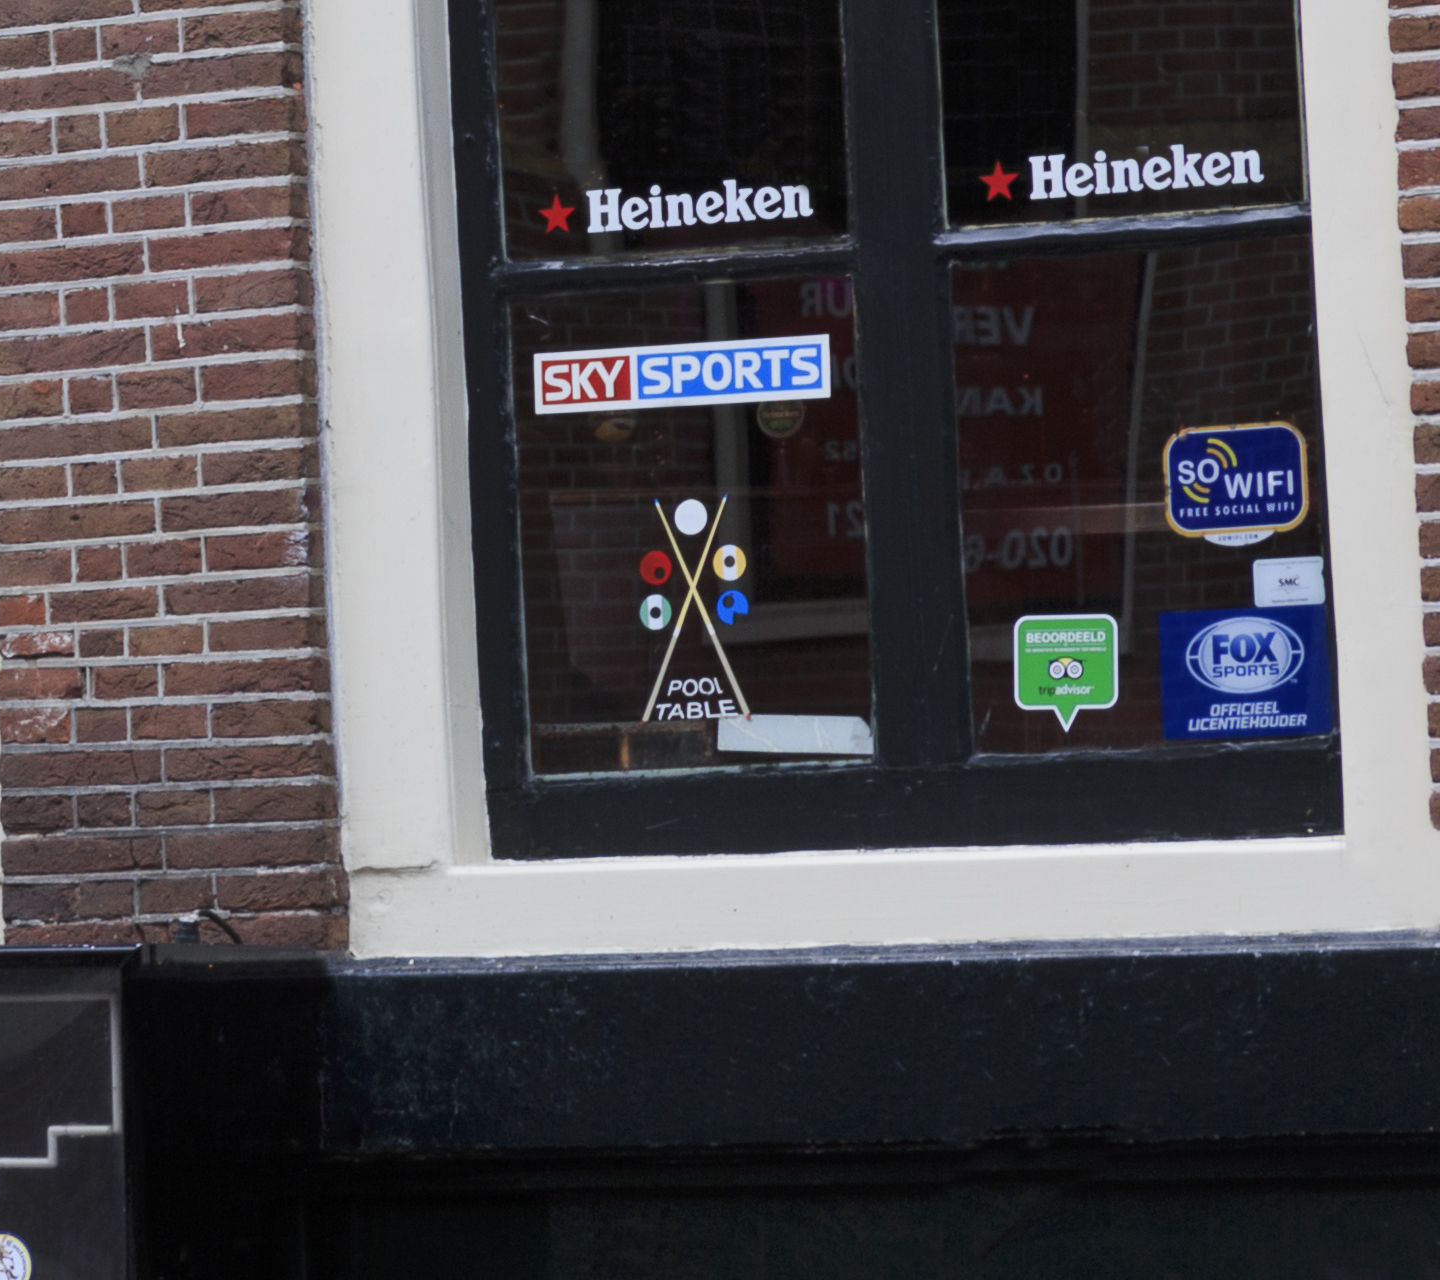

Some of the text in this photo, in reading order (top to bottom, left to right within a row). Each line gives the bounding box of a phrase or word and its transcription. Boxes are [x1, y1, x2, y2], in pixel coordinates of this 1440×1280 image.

[1028, 143, 1264, 202] Heineken
[585, 178, 813, 234] Heineken
[544, 360, 625, 404] SKY
[640, 346, 821, 397] SPORTS
[1178, 458, 1294, 499] SO WIFI
[1179, 502, 1295, 518] FREE SOCIAL WIFI
[1025, 631, 1107, 644] BEOORDEELD
[1211, 631, 1278, 665] FOX
[1212, 663, 1280, 678] SPORTS
[667, 676, 723, 697] POOL
[1038, 684, 1091, 697] tripadvisor
[656, 699, 739, 721] TABLE
[1210, 701, 1280, 717] OFFICIEEL
[1188, 714, 1308, 732] LICENTIEHOUDER
